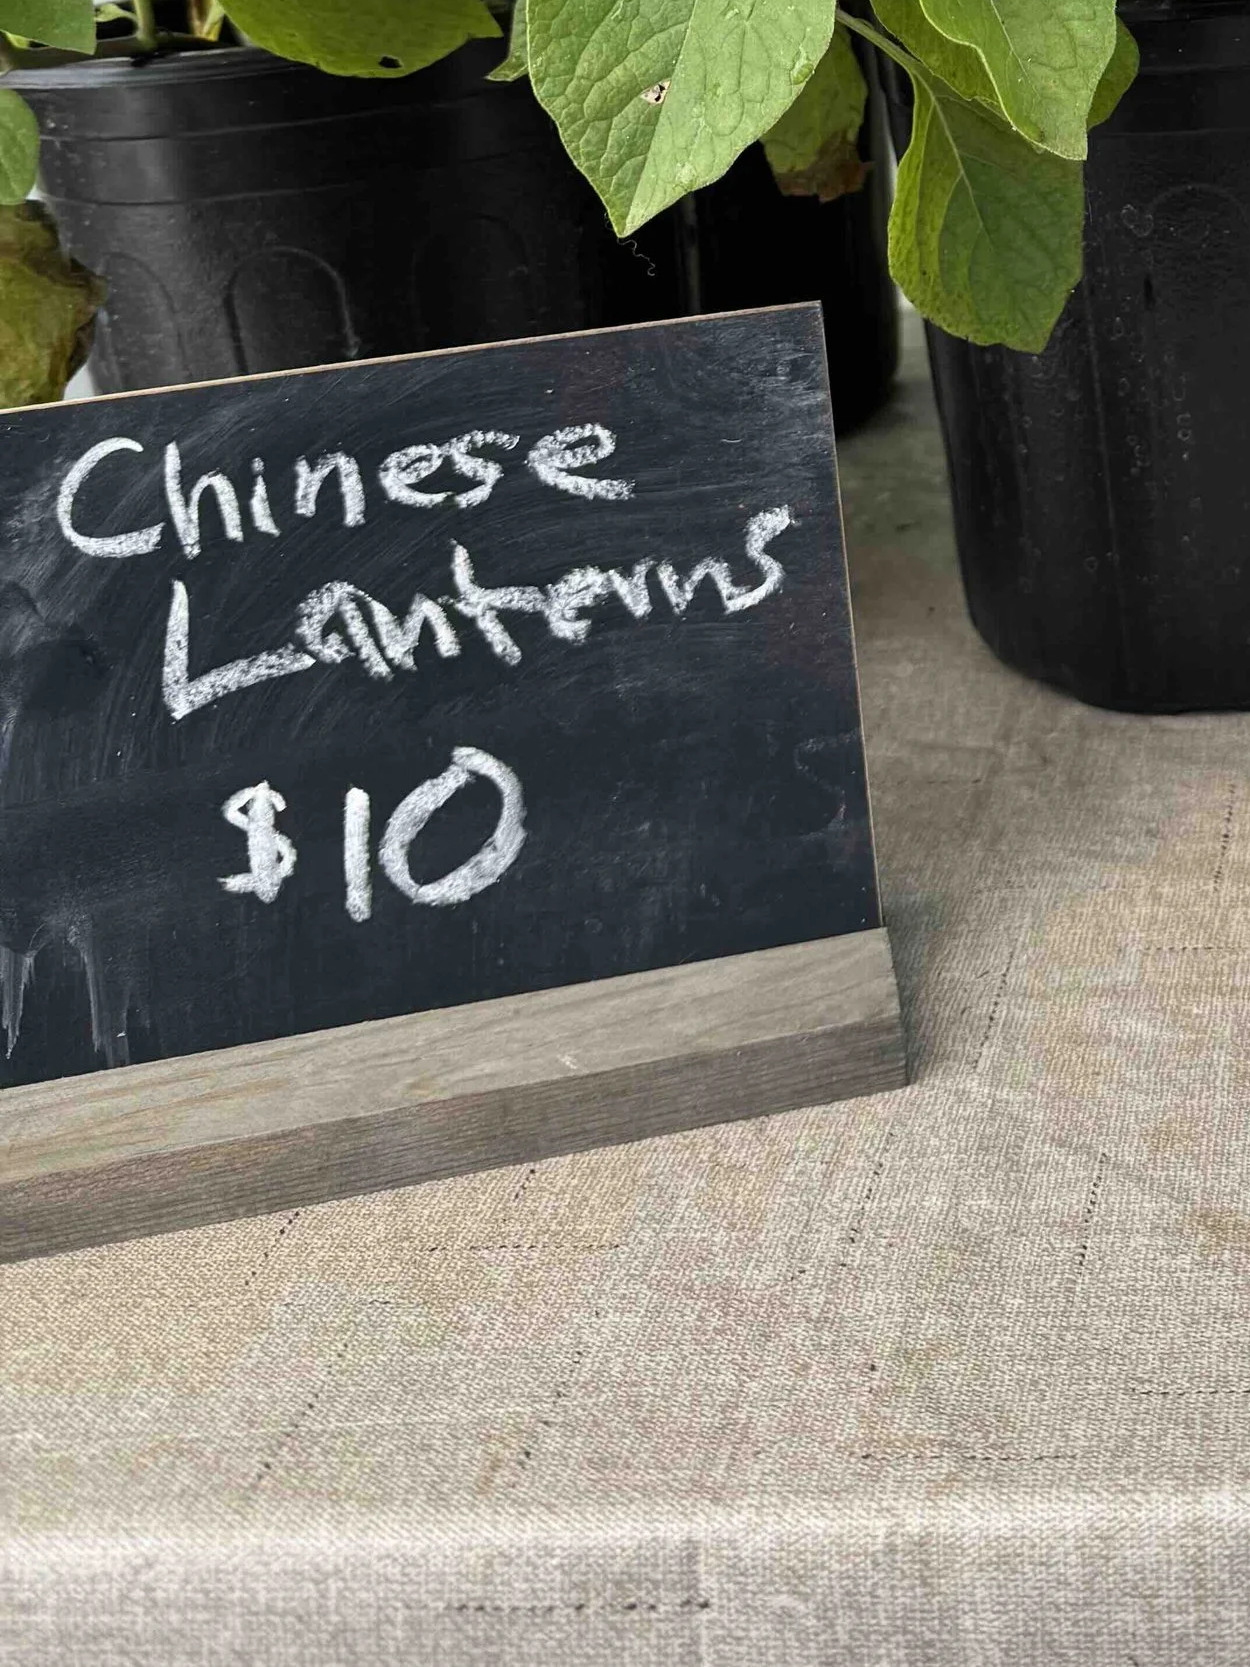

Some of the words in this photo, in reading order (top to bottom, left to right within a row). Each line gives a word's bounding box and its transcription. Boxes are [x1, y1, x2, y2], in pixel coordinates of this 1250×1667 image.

[57, 422, 637, 558] Chinese
[161, 504, 795, 721] Lanterns
[218, 746, 528, 923] $10
